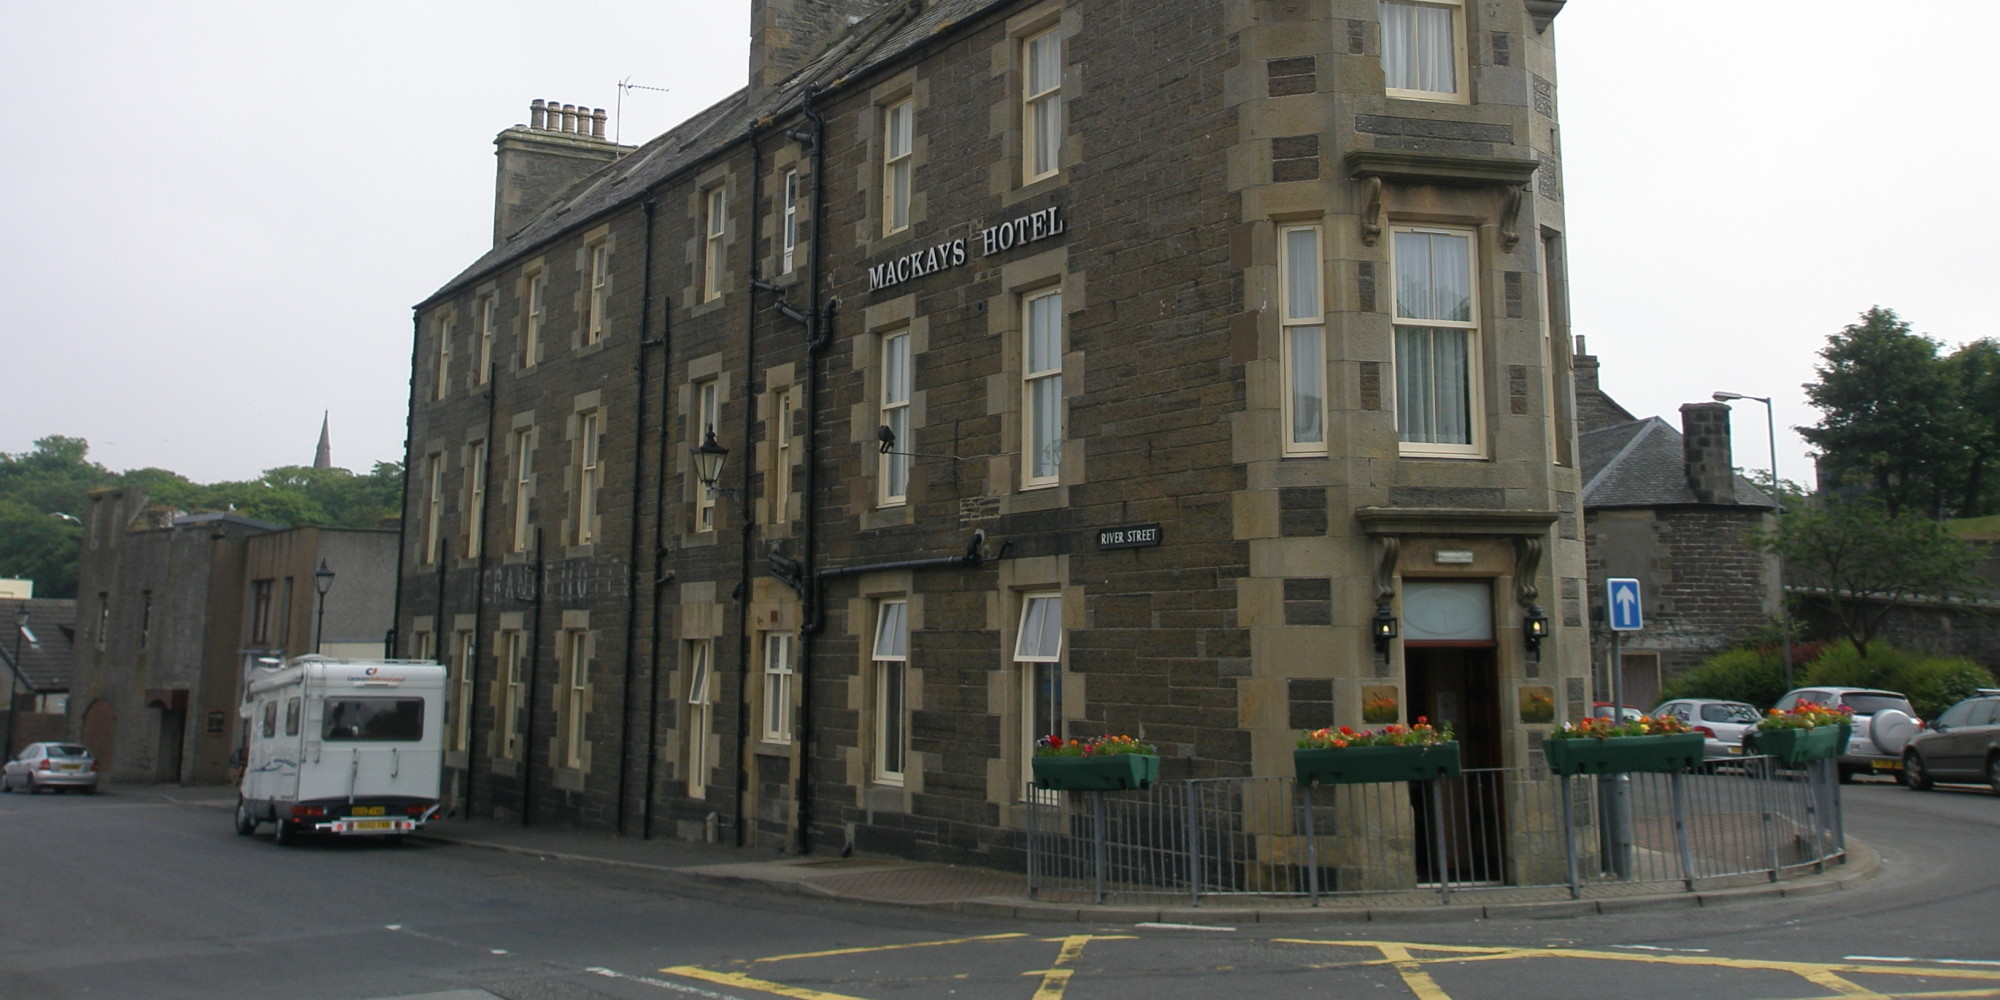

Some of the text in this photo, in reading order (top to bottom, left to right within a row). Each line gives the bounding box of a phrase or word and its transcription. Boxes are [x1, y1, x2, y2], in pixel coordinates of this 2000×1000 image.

[868, 206, 1063, 292] MACKAYS HOTEL
[1101, 528, 1157, 545] RIVER STREET
